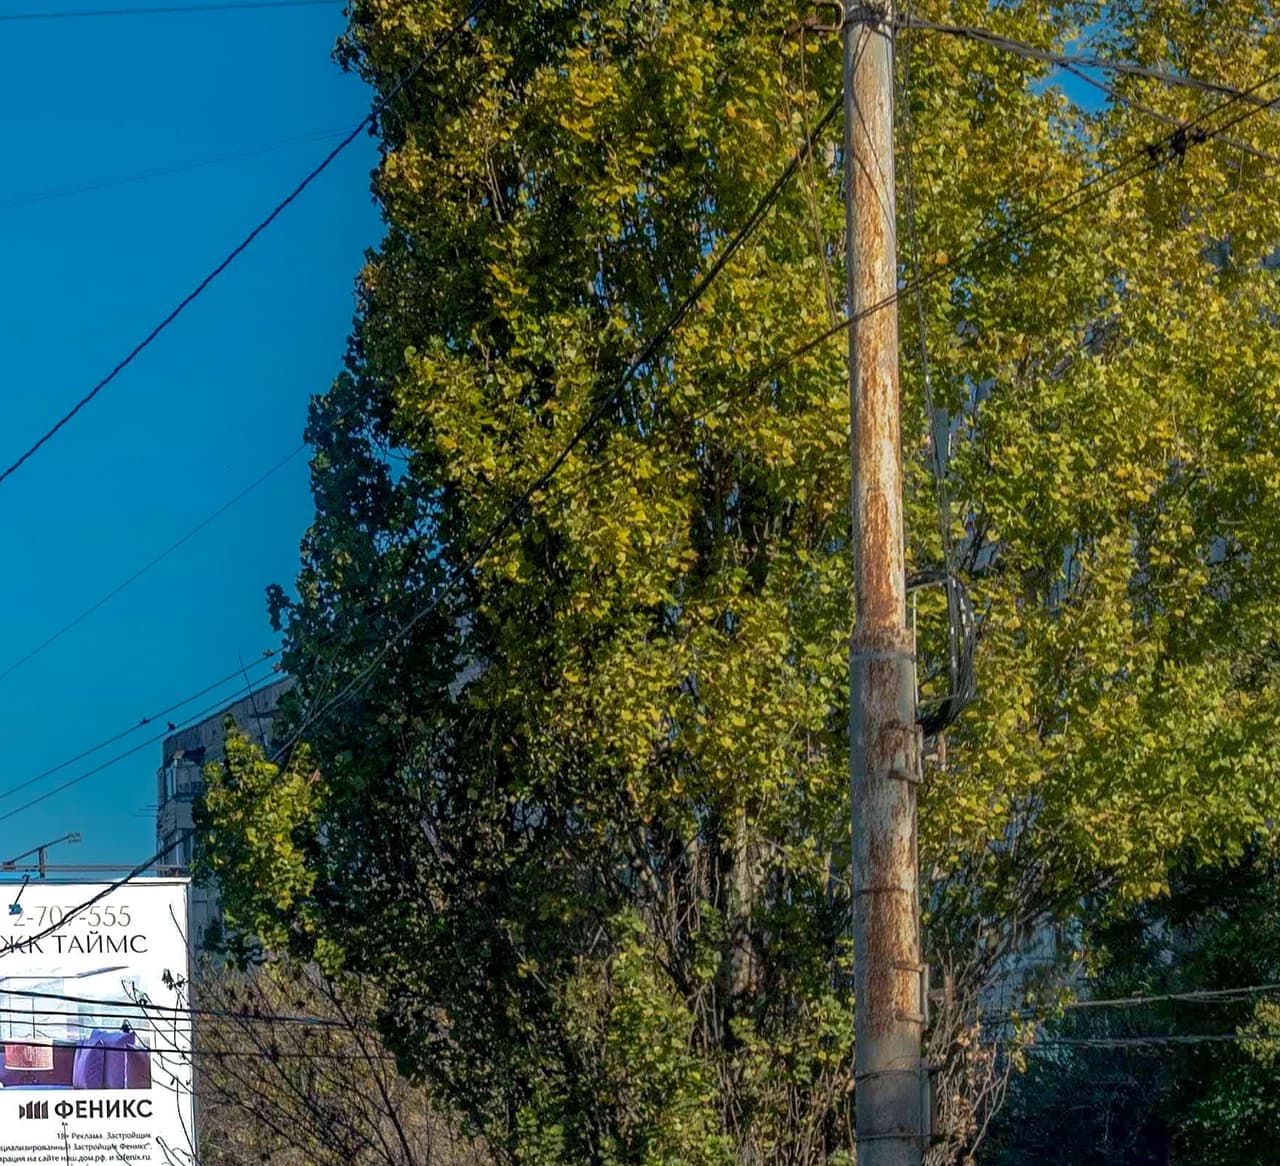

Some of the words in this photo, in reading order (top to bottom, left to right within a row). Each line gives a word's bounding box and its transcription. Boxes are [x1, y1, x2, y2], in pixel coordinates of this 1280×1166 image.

[1, 934, 45, 954] ЖК
[51, 930, 149, 954] ТАЙМС
[54, 1099, 153, 1120] ФЕНИКС
